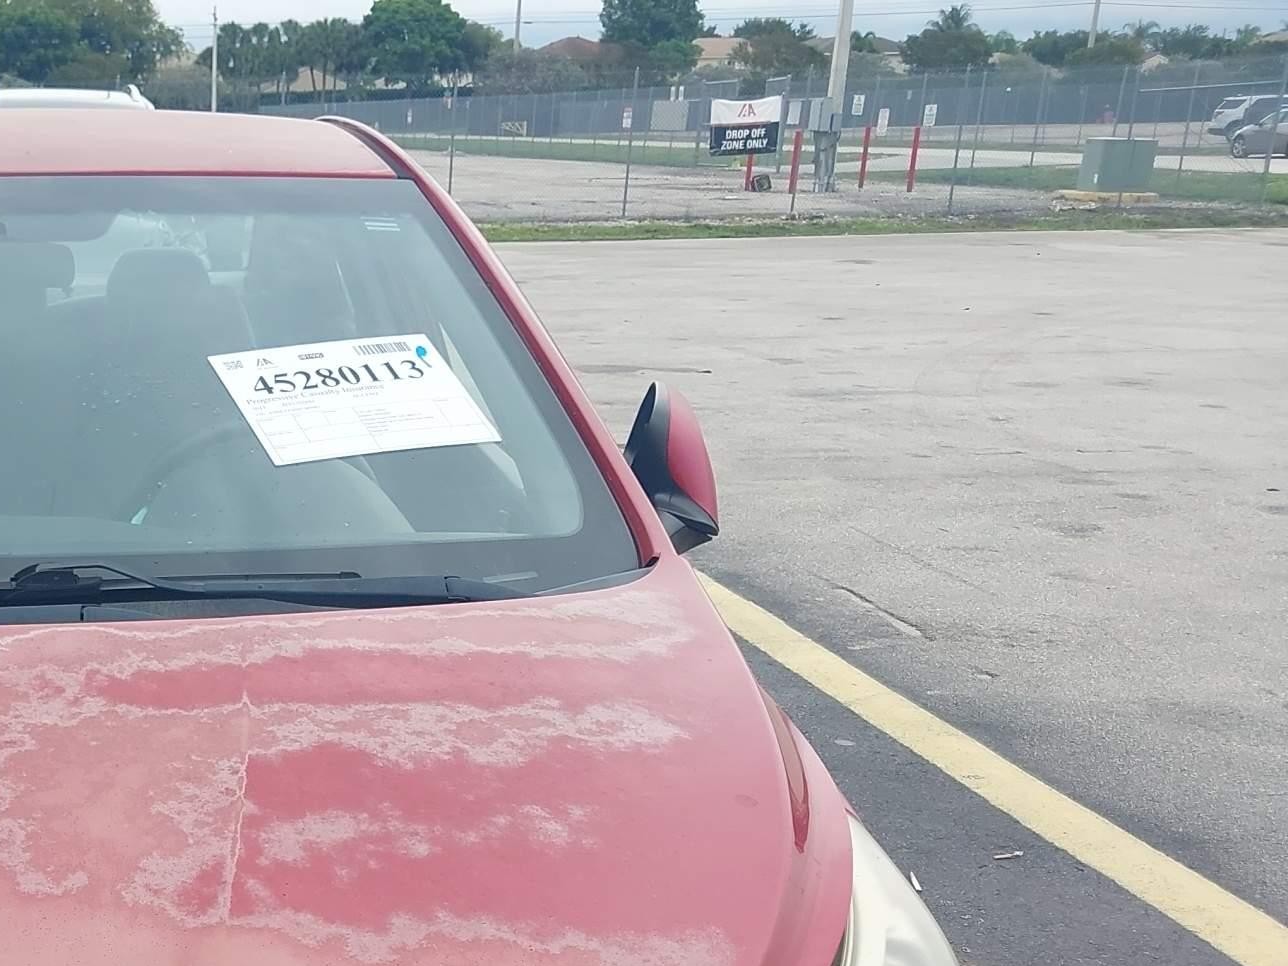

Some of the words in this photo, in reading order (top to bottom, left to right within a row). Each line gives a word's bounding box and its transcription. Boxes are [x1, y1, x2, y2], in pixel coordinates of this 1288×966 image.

[725, 129, 750, 140] DROP
[751, 128, 767, 138] OFF
[720, 140, 746, 151] ZONE
[746, 138, 769, 150] ONLY
[253, 359, 425, 394] 45280113
